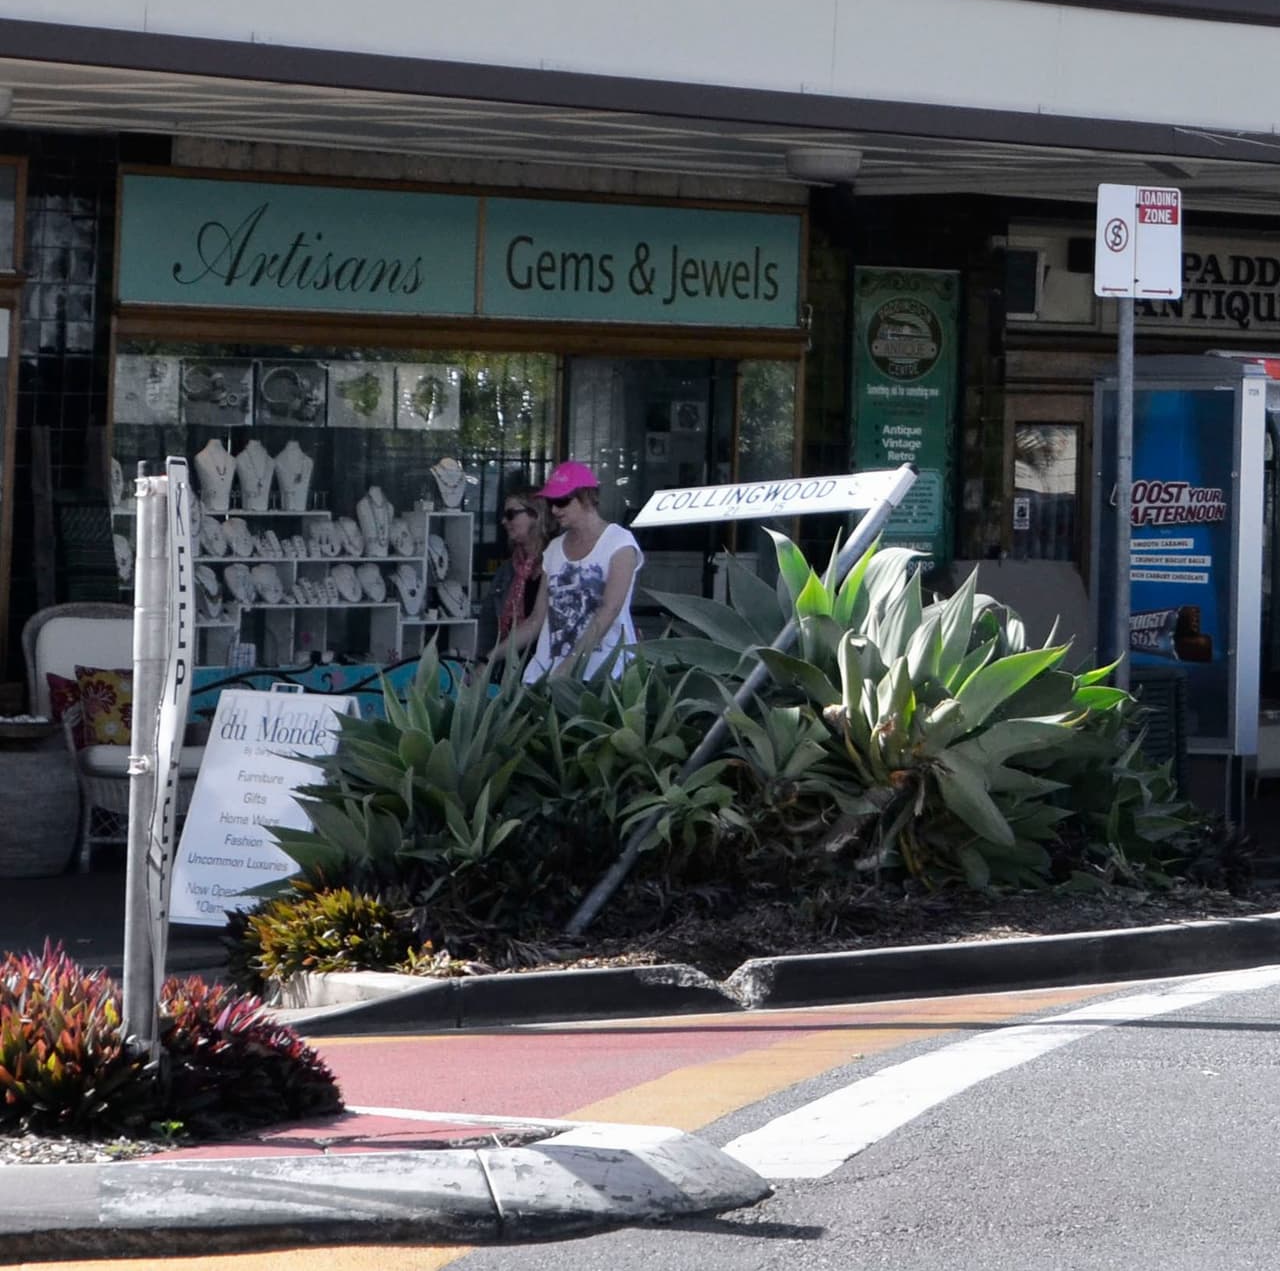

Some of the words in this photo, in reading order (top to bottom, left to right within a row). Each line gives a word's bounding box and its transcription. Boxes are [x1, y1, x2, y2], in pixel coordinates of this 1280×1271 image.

[1139, 191, 1177, 206] LOADING
[1144, 208, 1173, 223] ZONE
[172, 202, 424, 295] Artisans
[505, 235, 615, 294] Gems
[628, 241, 656, 296] &
[662, 244, 779, 305] Jewels
[882, 425, 922, 436] Antique
[882, 439, 922, 450] Vintage
[887, 451, 915, 461] Retro
[656, 480, 837, 512] COLLINGWOOD
[1111, 480, 1189, 505] OOST
[1188, 488, 1222, 503] YOUR
[1130, 505, 1226, 526] AFTERNOON
[174, 482, 186, 706] KEEP
[221, 715, 247, 741] du
[256, 716, 327, 746] Monde
[238, 770, 284, 785] Furniture
[243, 793, 267, 805] Gifts
[219, 812, 249, 825] Home
[224, 834, 263, 847] Fashion
[187, 852, 244, 867] Uncommon
[246, 858, 288, 872] Luxuries
[185, 882, 209, 894] Now
